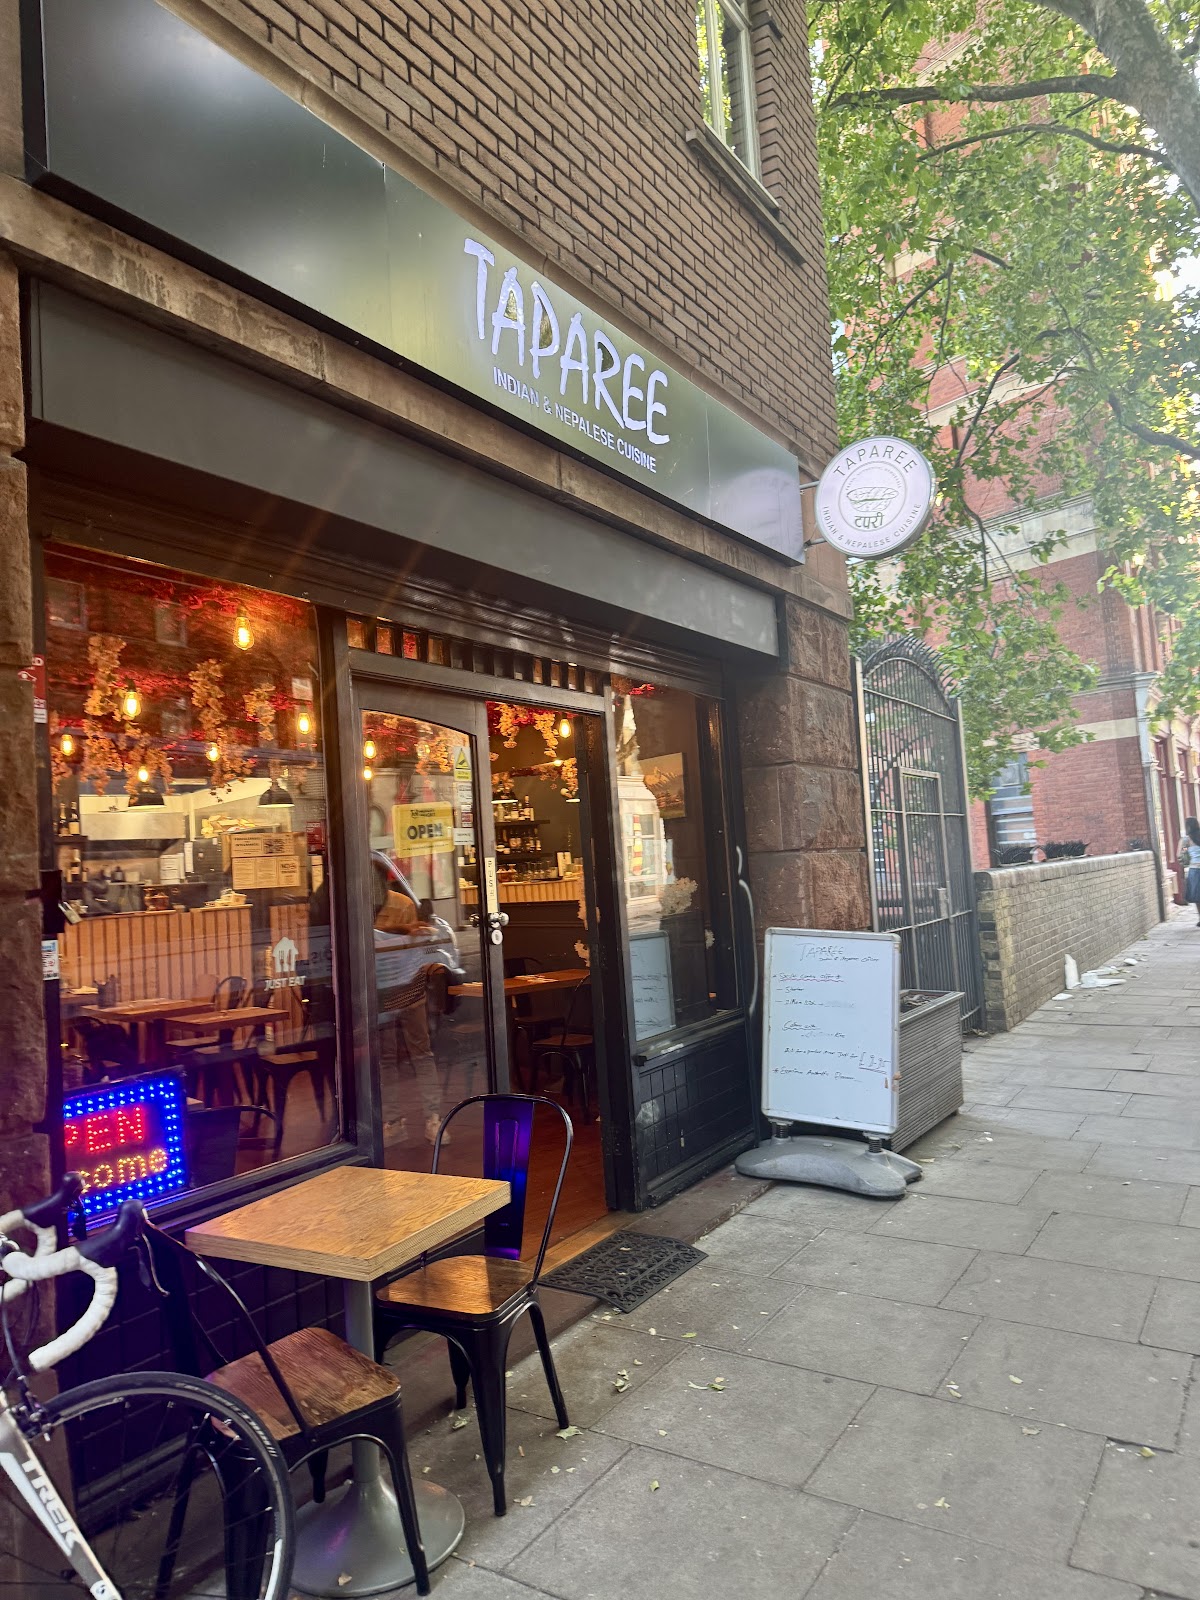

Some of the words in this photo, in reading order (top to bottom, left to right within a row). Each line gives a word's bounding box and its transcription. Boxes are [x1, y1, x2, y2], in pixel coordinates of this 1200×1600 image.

[463, 238, 670, 445] TAPAREE
[493, 366, 540, 408] INDIAN
[543, 396, 553, 415] &
[555, 402, 615, 451] NEPALESE
[616, 437, 657, 473] CUISINE
[833, 445, 918, 476] TAPAREE
[822, 506, 838, 535] INDIAN
[845, 537, 890, 549] NEPALESE
[893, 504, 922, 538] CUISINE
[407, 823, 443, 840] OPEN
[264, 978, 288, 991] JUST
[288, 975, 307, 987] EAT
[22, 1459, 82, 1551] TREK
